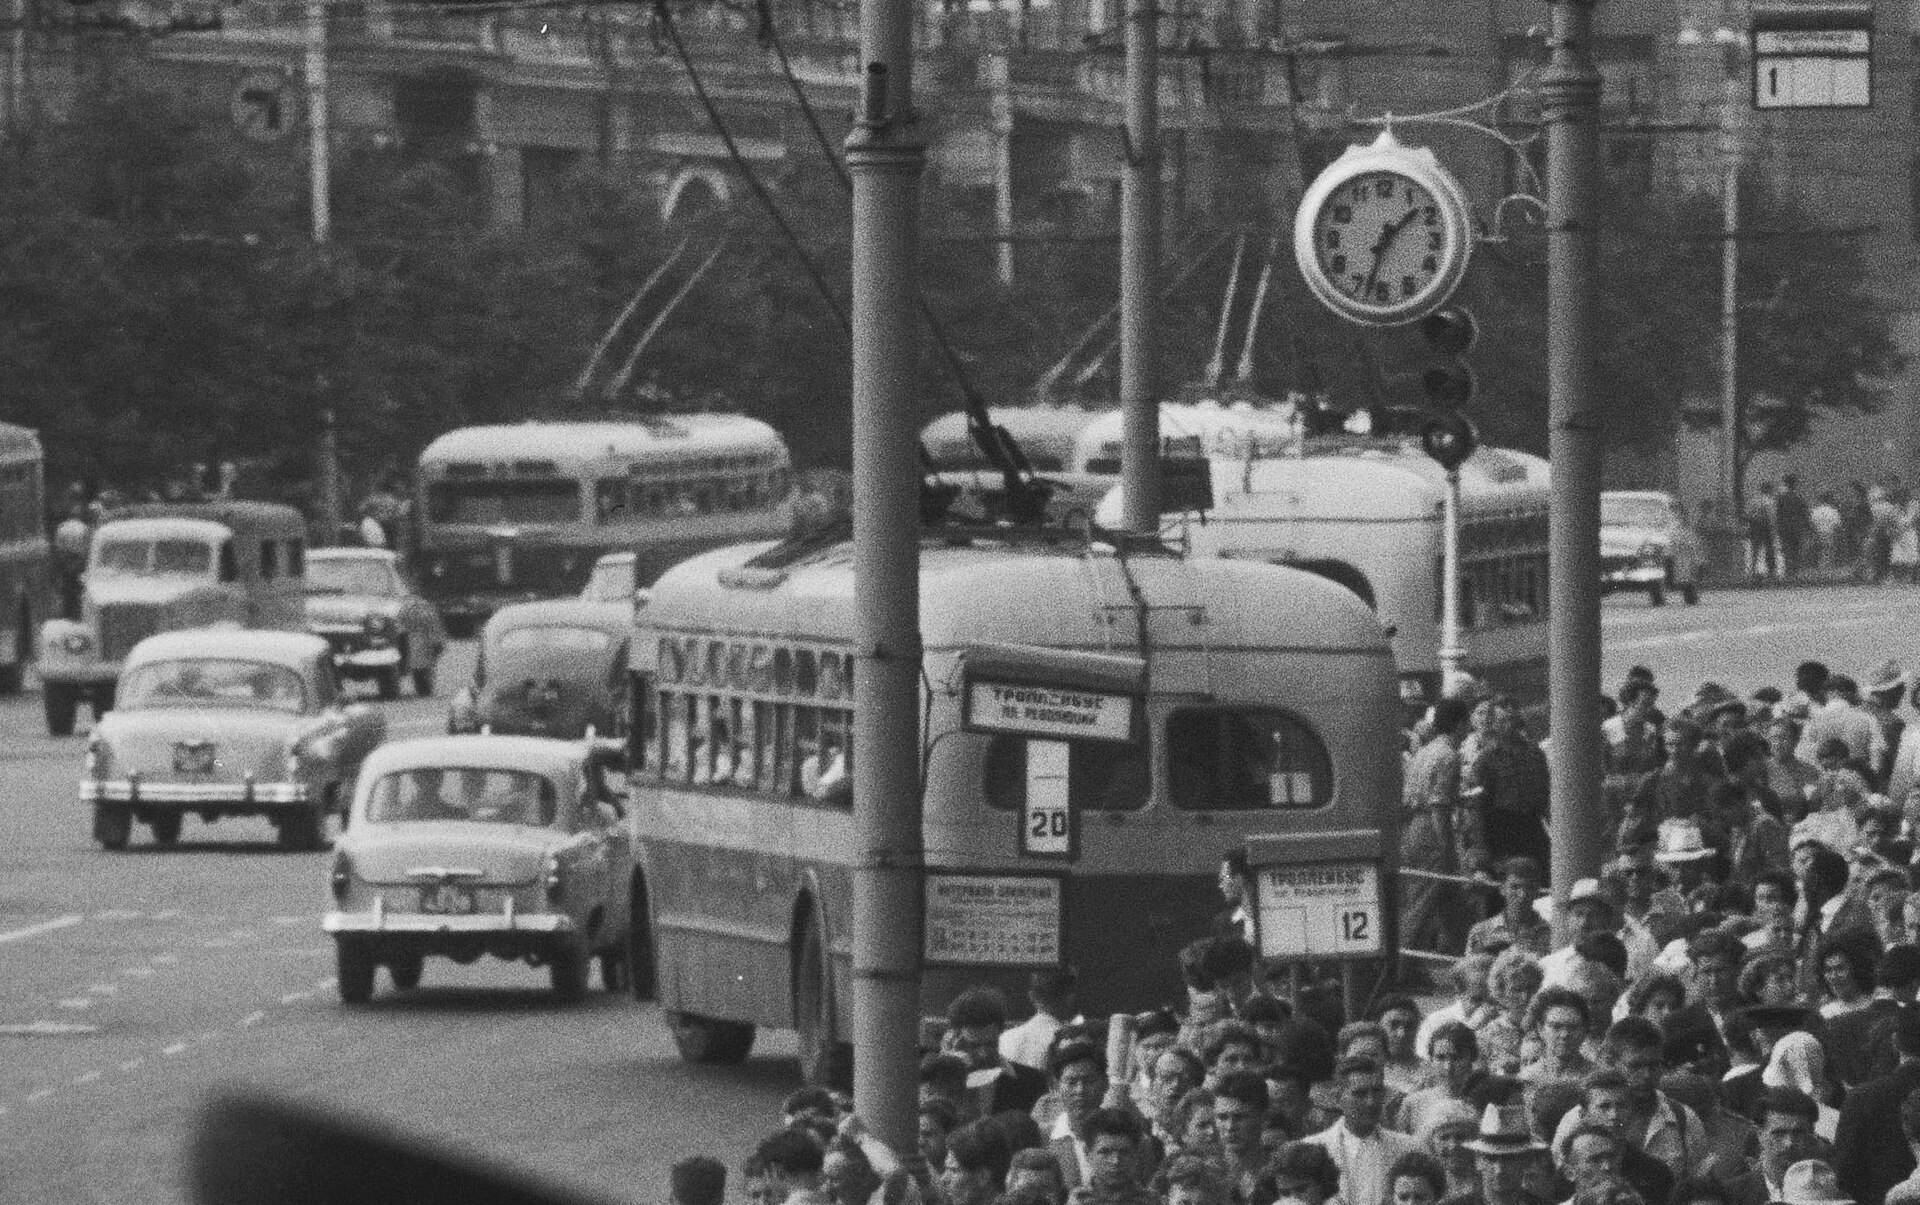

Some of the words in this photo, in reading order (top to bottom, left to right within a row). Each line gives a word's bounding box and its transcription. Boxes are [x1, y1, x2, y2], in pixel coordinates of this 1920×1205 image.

[1769, 67, 1778, 97] 1
[1352, 186, 1368, 201] 11
[1376, 180, 1393, 198] 12
[1404, 188, 1412, 202] 1
[1424, 205, 1437, 225] 2
[1428, 231, 1441, 251] 3
[1351, 272, 1364, 292] 7
[1032, 811, 1066, 837] 20
[1342, 912, 1369, 940] 12
